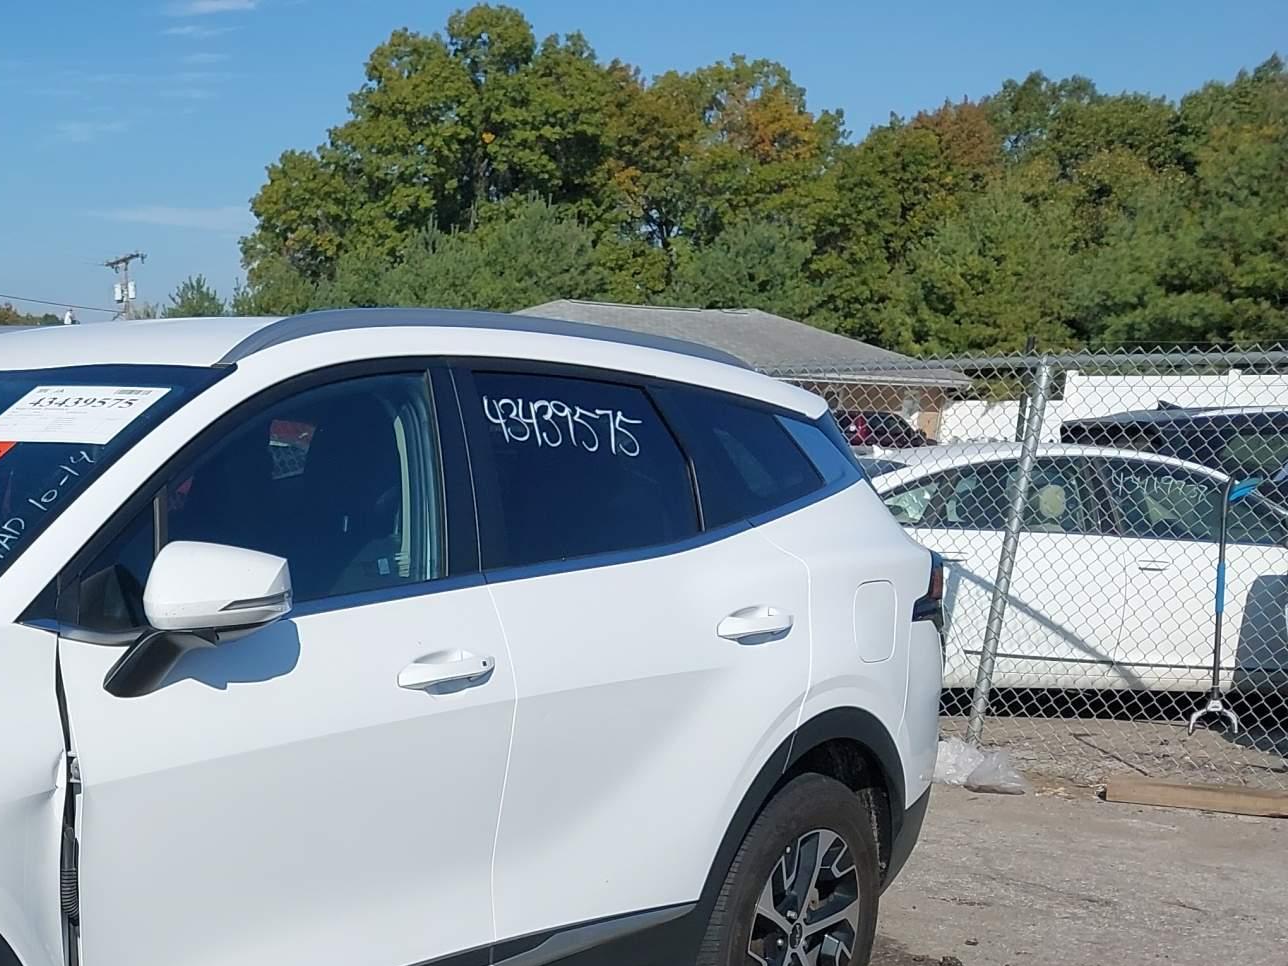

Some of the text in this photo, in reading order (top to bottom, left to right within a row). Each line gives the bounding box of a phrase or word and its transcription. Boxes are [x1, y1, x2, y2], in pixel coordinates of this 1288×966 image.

[28, 397, 139, 409] 43439575
[482, 395, 643, 457] 43439575
[28, 450, 96, 511] 10-14
